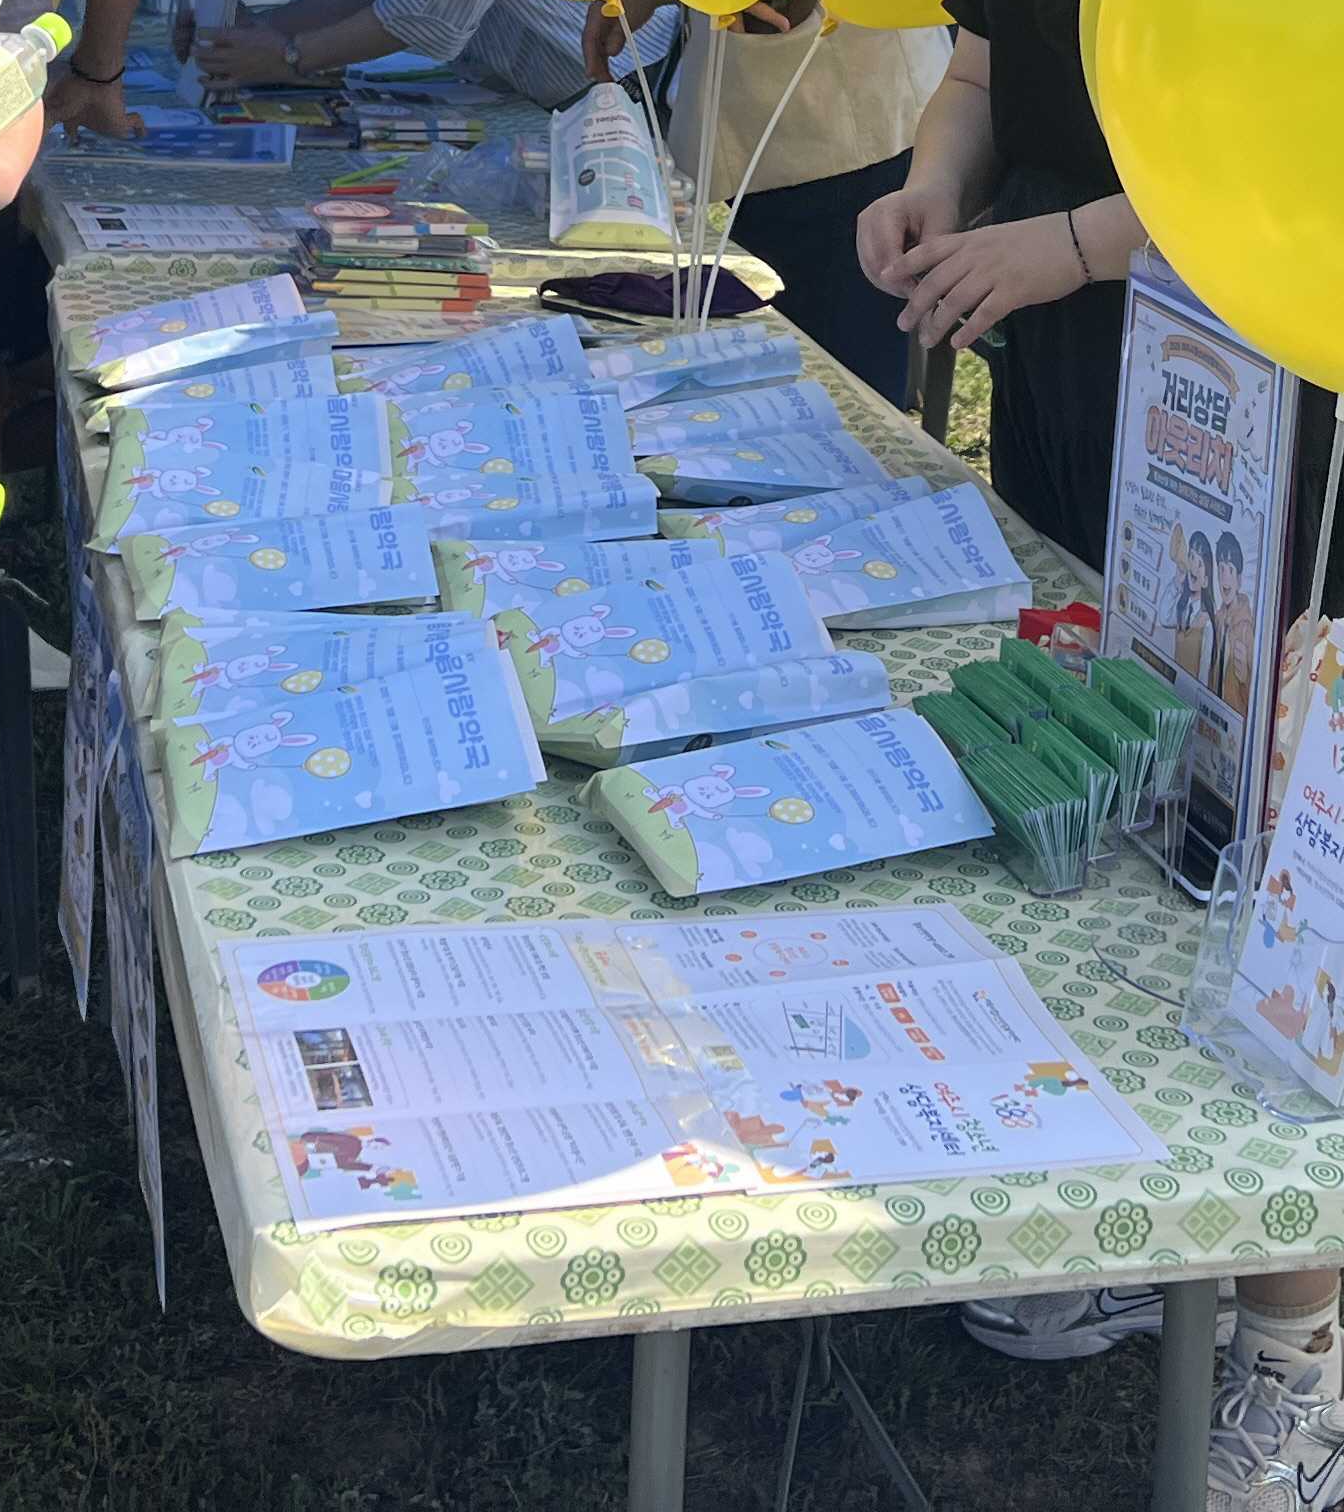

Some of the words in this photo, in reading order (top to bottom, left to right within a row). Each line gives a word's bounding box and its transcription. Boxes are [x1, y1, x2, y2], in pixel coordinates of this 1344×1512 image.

[1161, 369, 1232, 436] 거리상담
[1145, 405, 1234, 496] 아웃리치
[1303, 785, 1342, 825] 여주시
[899, 1083, 966, 1156] 상담복지센터
[934, 1081, 971, 1118] 여주시
